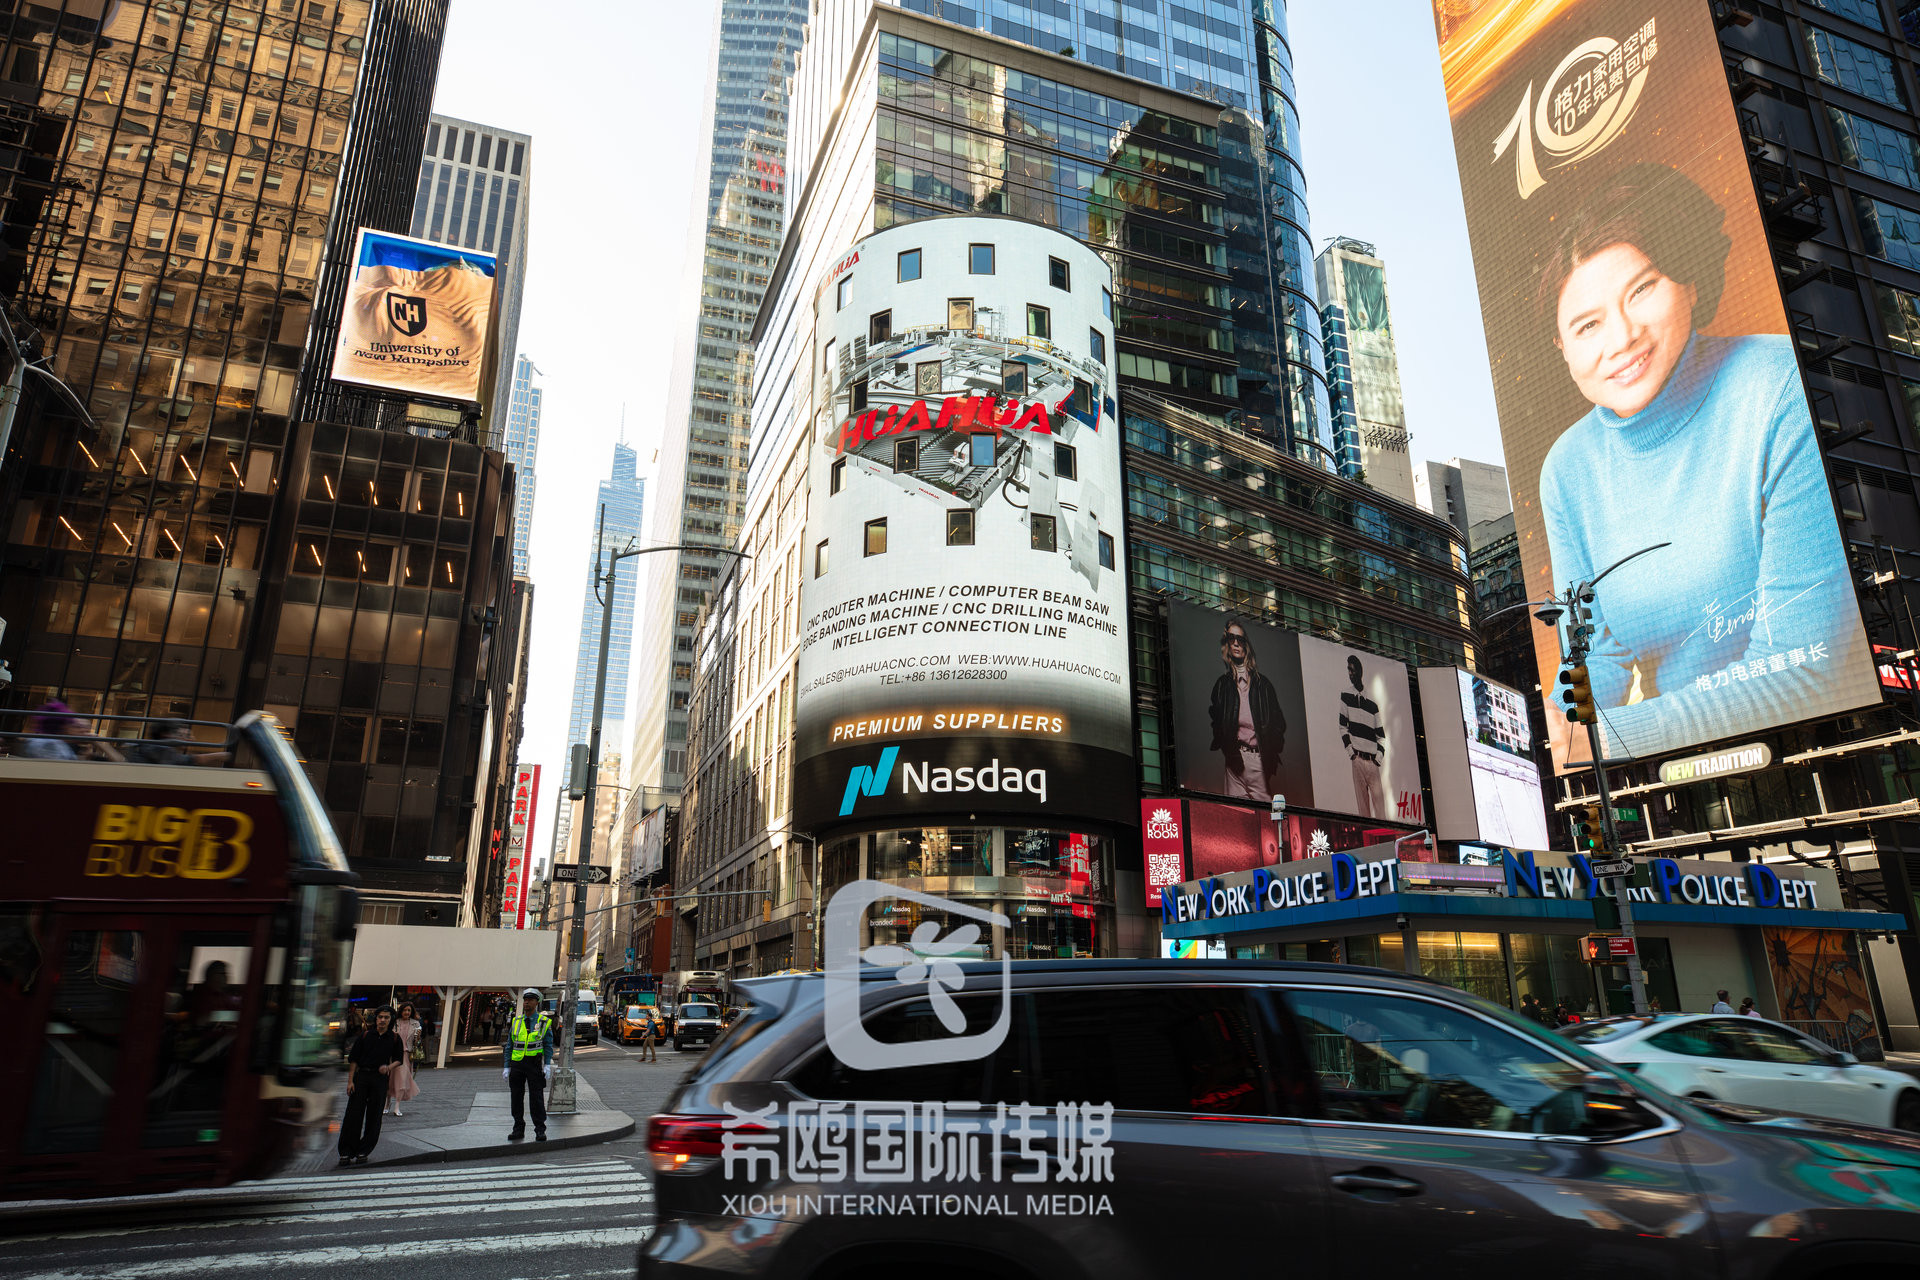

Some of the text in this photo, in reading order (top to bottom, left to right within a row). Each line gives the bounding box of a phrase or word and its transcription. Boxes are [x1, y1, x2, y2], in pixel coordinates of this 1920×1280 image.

[1554, 16, 1656, 119] 格力家用空调
[1553, 37, 1659, 136] 10年免费包修
[394, 302, 420, 323] NH
[354, 350, 470, 367] New Hampshire
[370, 342, 460, 357] University of
[806, 613, 821, 631] CNC
[821, 597, 865, 622] ROUTER
[867, 586, 936, 607] MACHINE
[949, 585, 1039, 600] COMPUTER
[1043, 590, 1082, 607] BEAM
[1085, 599, 1110, 616] SAW
[802, 633, 818, 652] EDGE
[819, 613, 867, 640] BANDING
[870, 603, 940, 624] MACHINE
[952, 602, 987, 614] CNC
[991, 603, 1064, 621] DRILLING
[1067, 611, 1118, 637] MACHINE
[832, 620, 1068, 651] INTELLIGENT CONNECTION LINE
[880, 669, 1008, 686] TEL:+86 13612628300
[958, 654, 1121, 685] WEB:WWW.HUAHUACNC.COM
[1695, 641, 1830, 693] 格力电器董事长
[832, 713, 1064, 743] PREMIUM SUPPLIERS
[902, 758, 1047, 804] Nasdaq
[514, 772, 530, 826] PARK
[1397, 790, 1422, 822] H&M
[92, 803, 190, 843] BIG
[1147, 823, 1178, 831] LOTUS
[1147, 830, 1179, 839] ROOM
[84, 843, 183, 878] BUS
[1595, 863, 1628, 873] ONE WAY
[503, 857, 521, 913] PARK
[891, 906, 911, 914] Nasdaq
[1026, 906, 1047, 914] Nasdaq
[1032, 944, 1052, 952] Nasdaq
